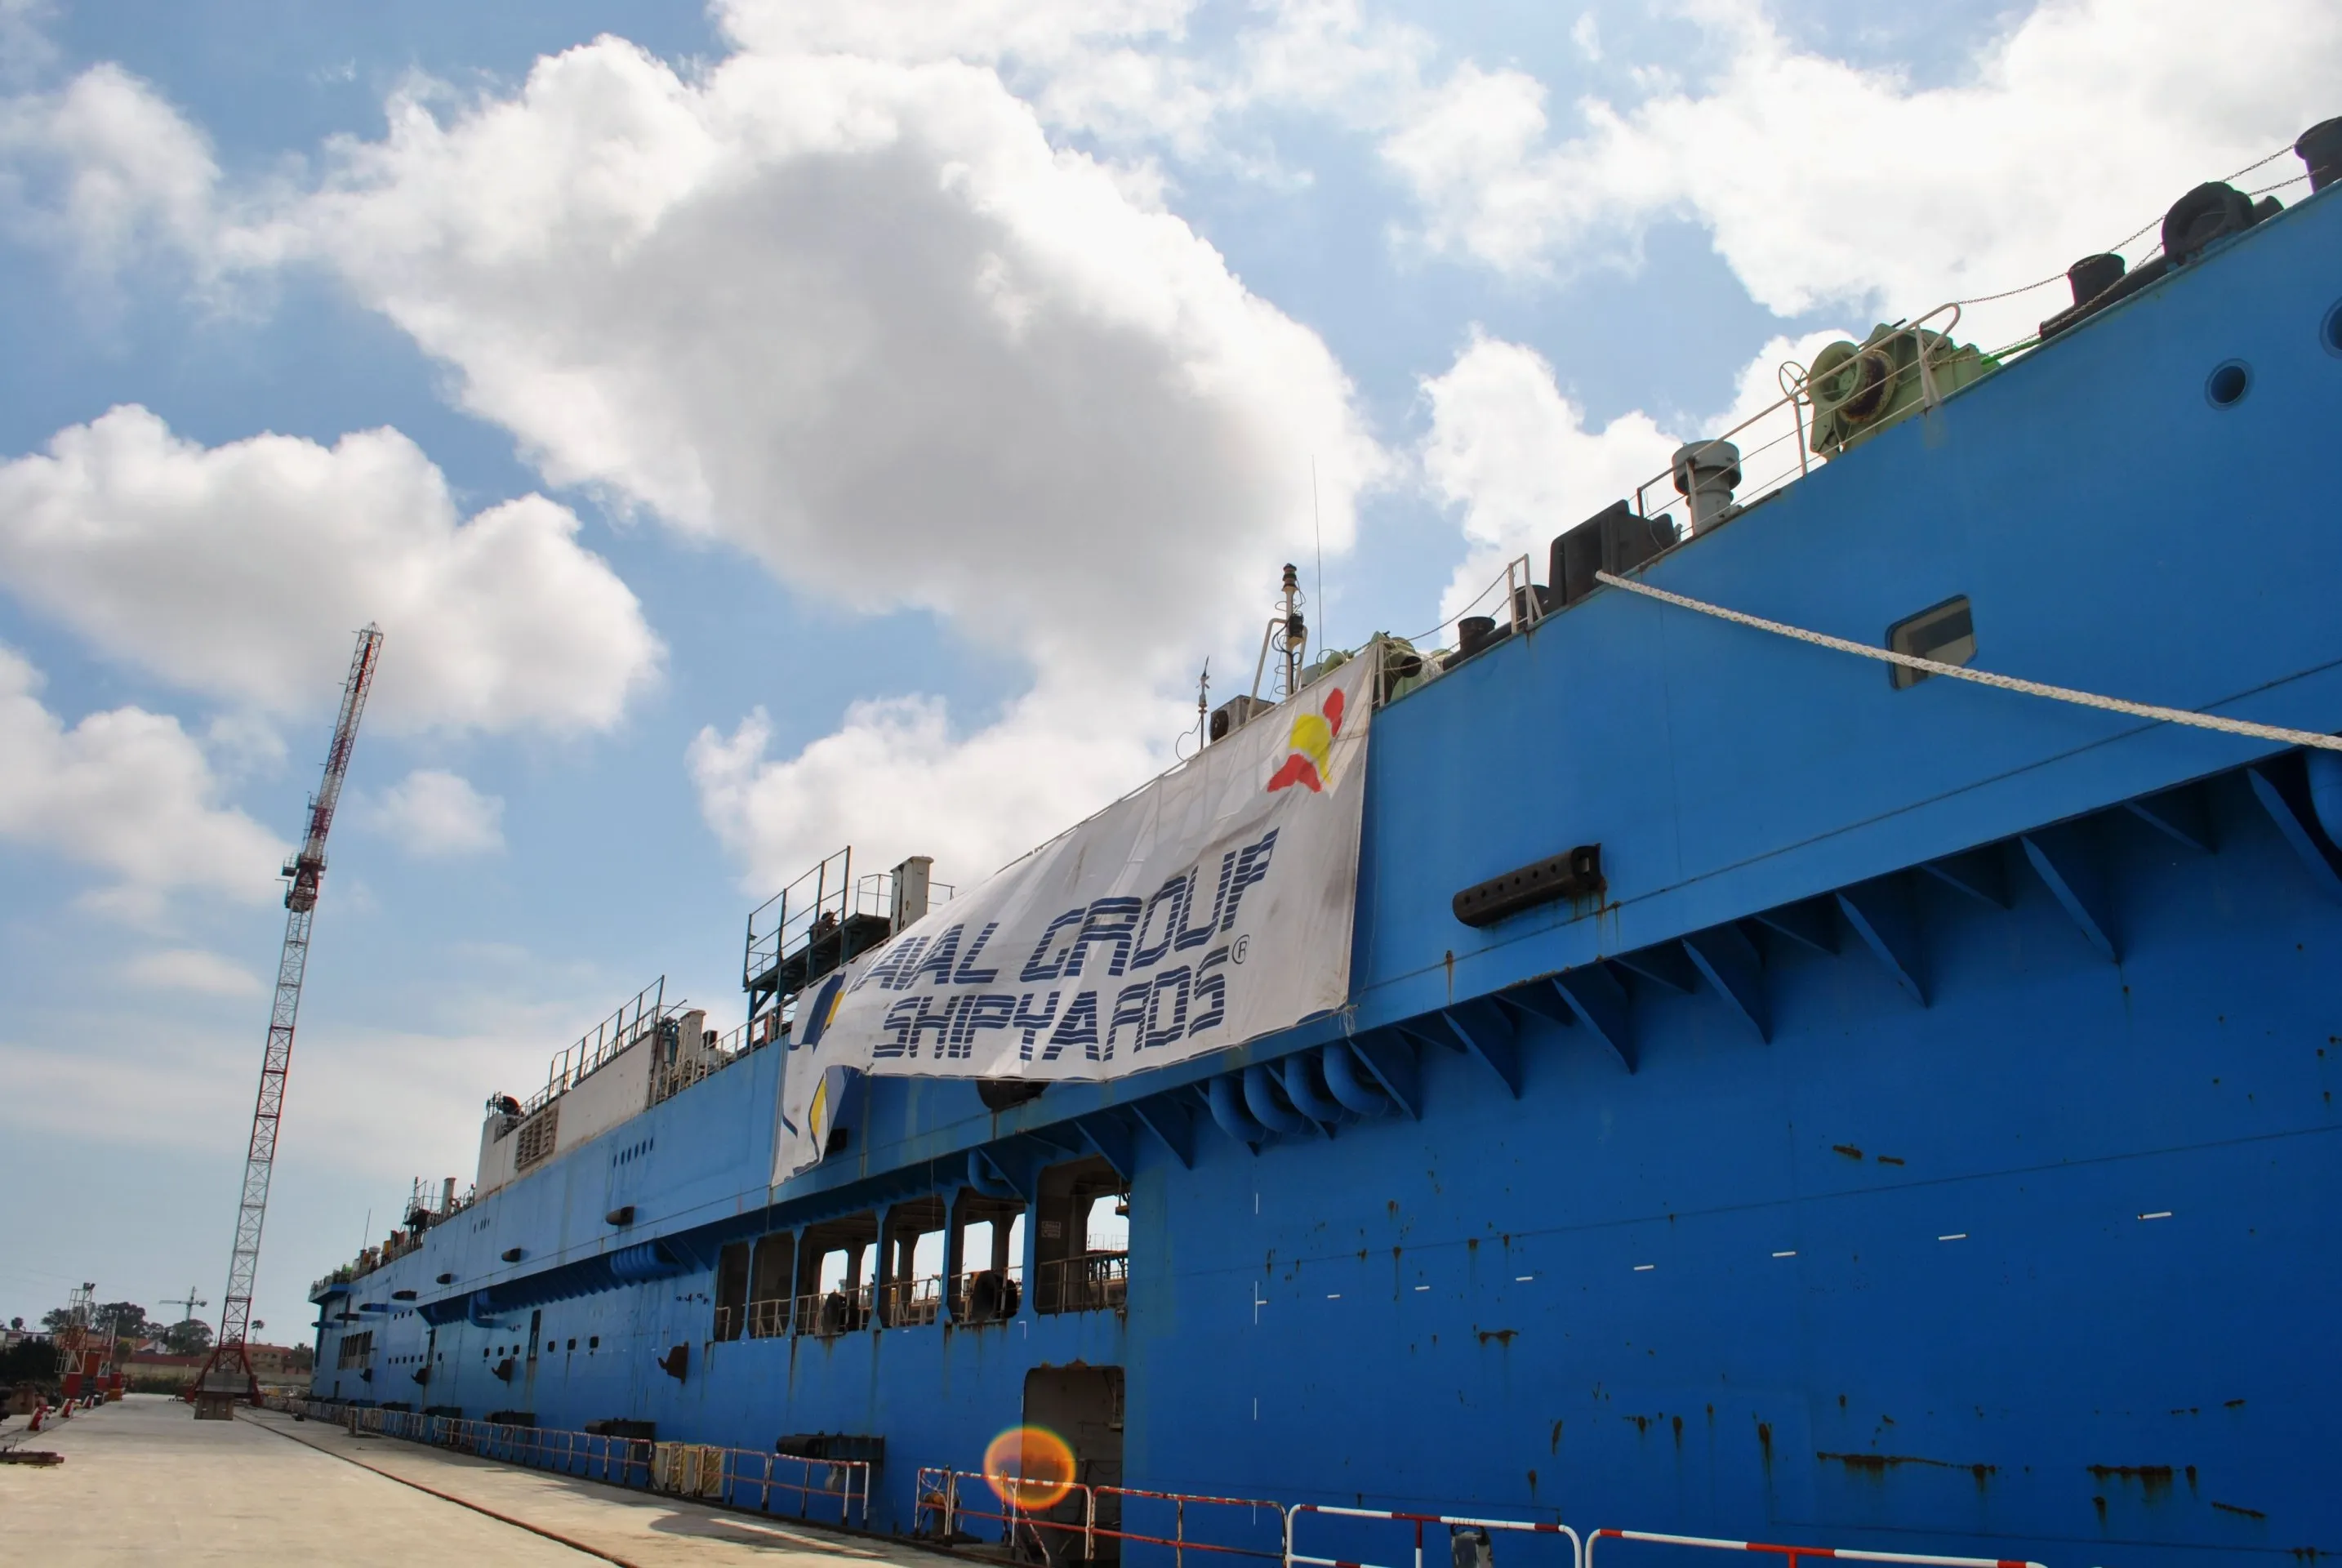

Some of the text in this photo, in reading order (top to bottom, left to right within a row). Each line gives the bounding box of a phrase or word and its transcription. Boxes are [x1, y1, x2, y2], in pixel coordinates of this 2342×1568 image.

[847, 826, 1280, 995] AVAL GROUP
[872, 945, 1229, 1062] SHIPYARDS
